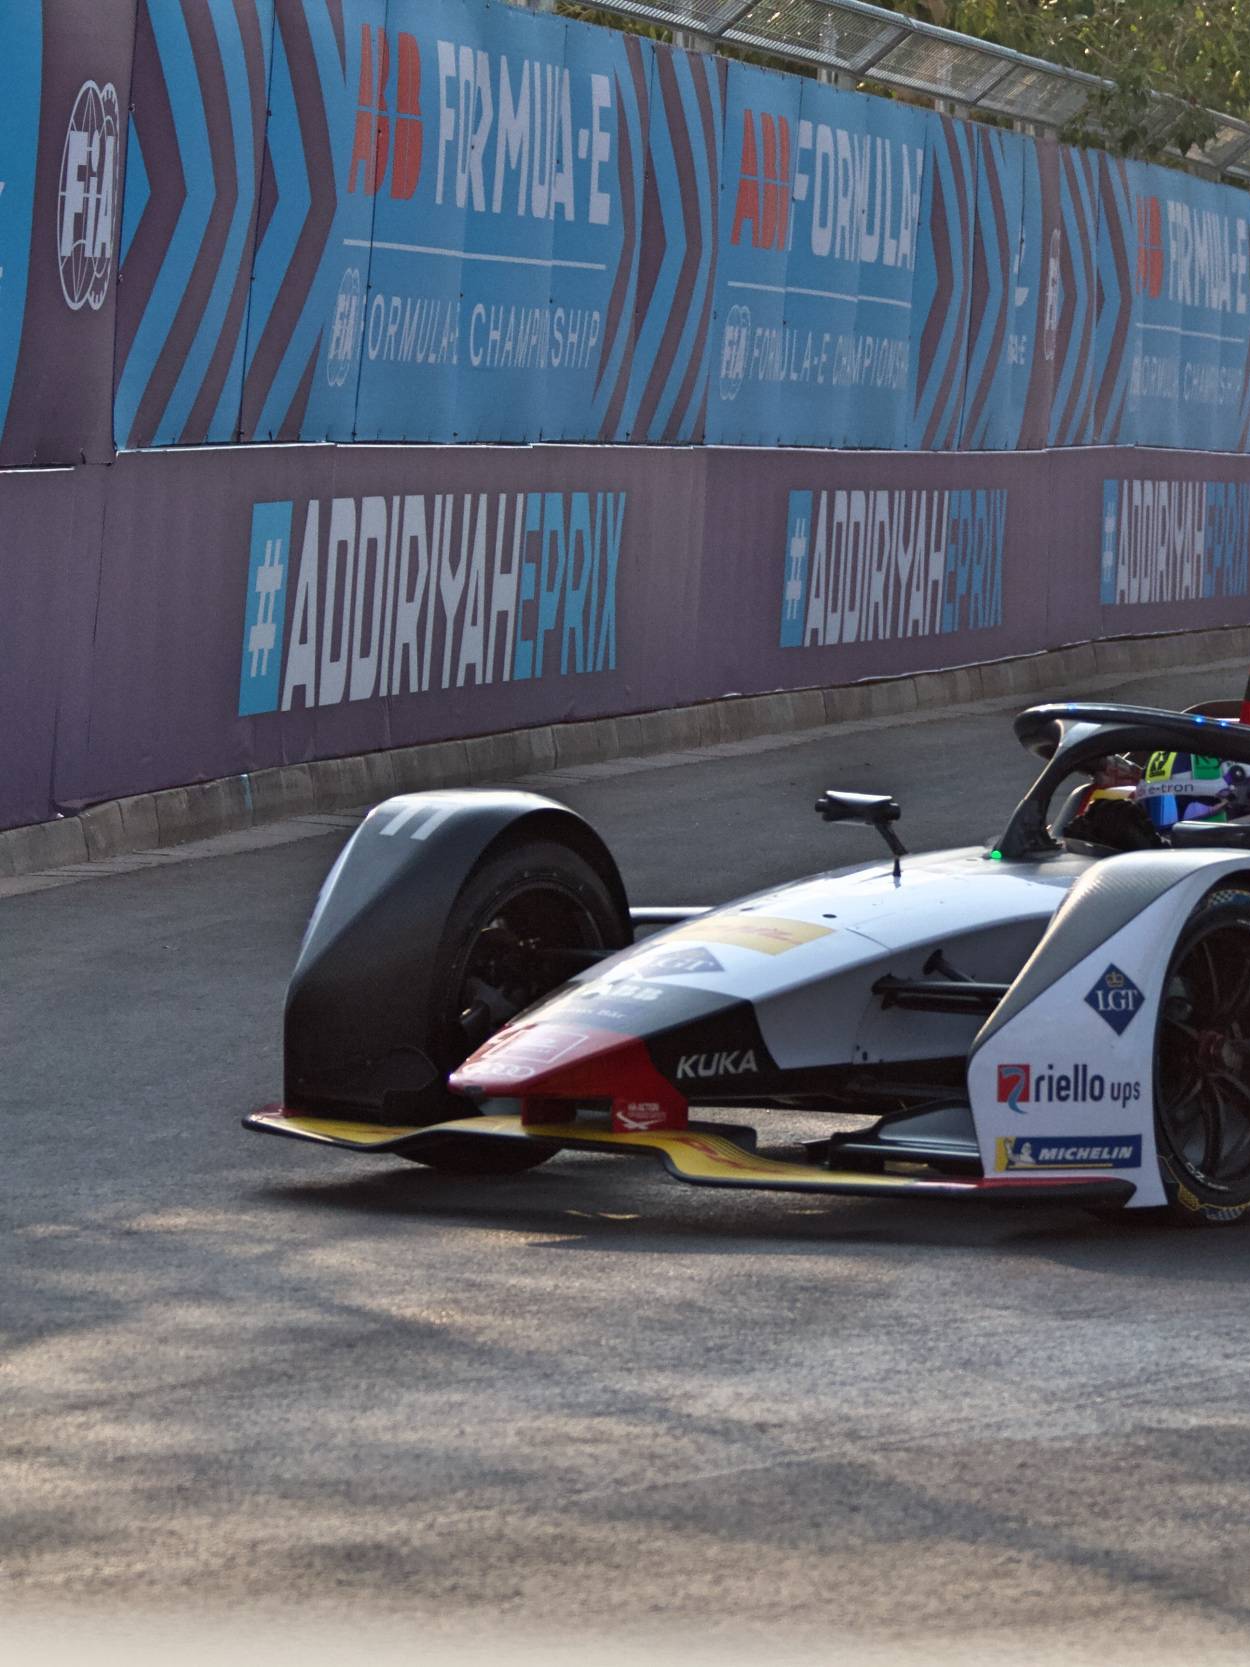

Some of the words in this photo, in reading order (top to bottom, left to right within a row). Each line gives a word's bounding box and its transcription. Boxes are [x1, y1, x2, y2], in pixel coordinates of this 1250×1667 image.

[1096, 989, 1139, 1012] LGT
[676, 1050, 758, 1079] KUKA
[1034, 1063, 1105, 1103] riello
[1111, 1081, 1141, 1109] ups
[1038, 1146, 1134, 1161] MICHELIN
